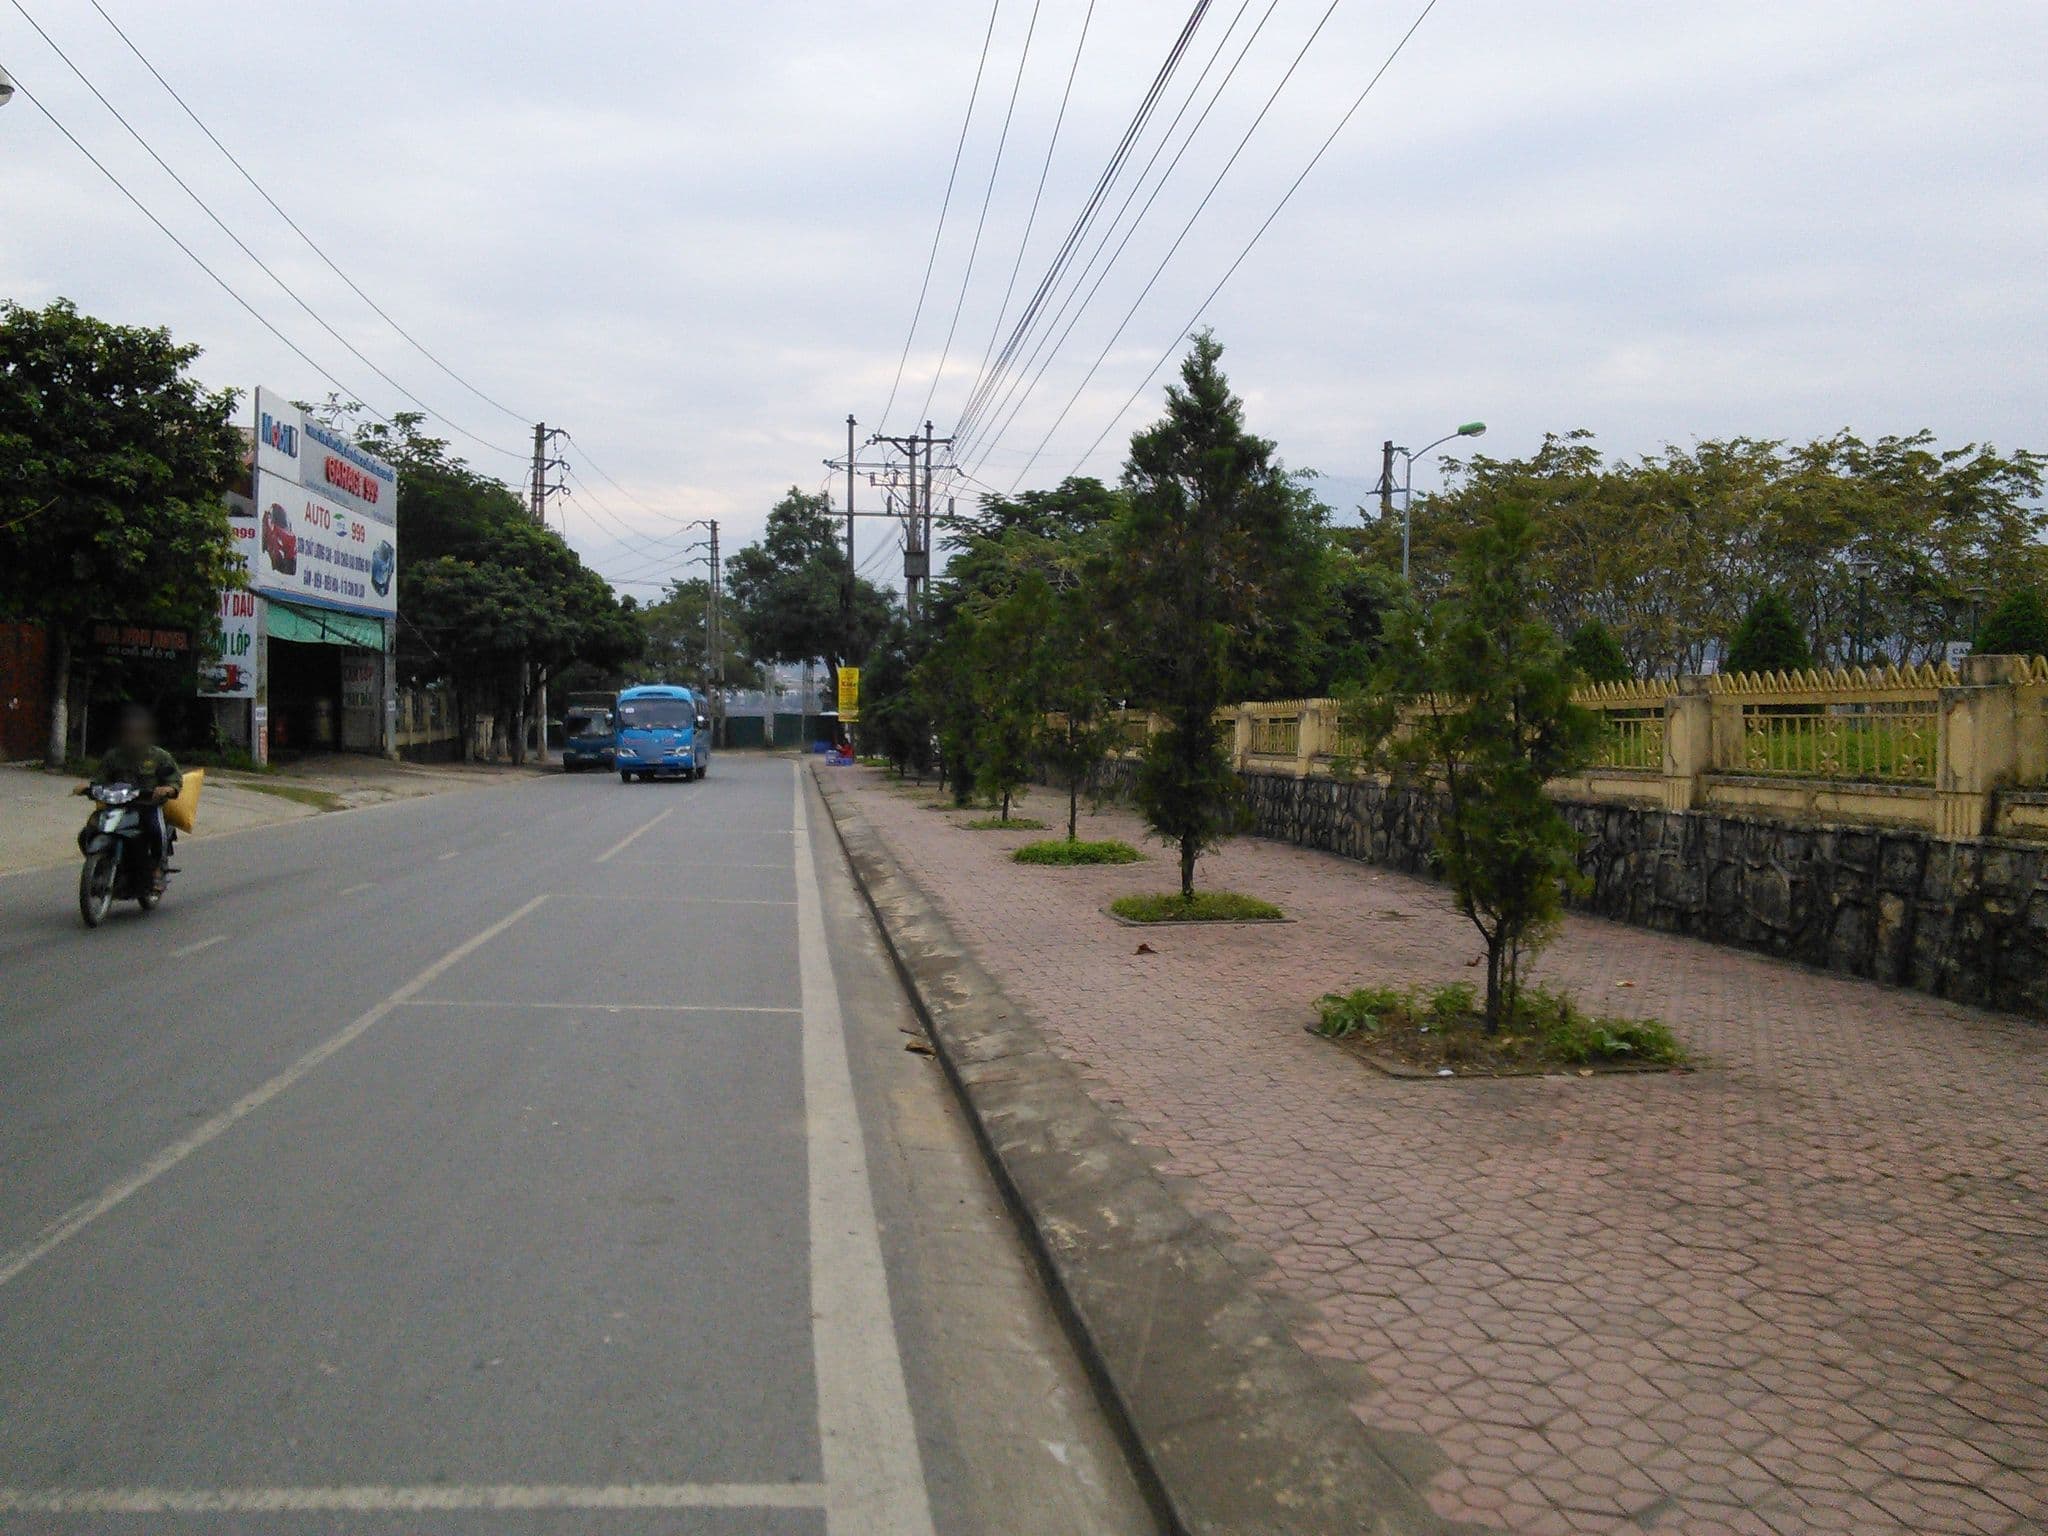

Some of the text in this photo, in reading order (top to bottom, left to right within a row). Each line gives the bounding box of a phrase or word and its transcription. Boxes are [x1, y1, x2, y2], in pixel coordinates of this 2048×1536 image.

[304, 501, 366, 543] AUTO 999
[230, 624, 251, 657] LỐP
